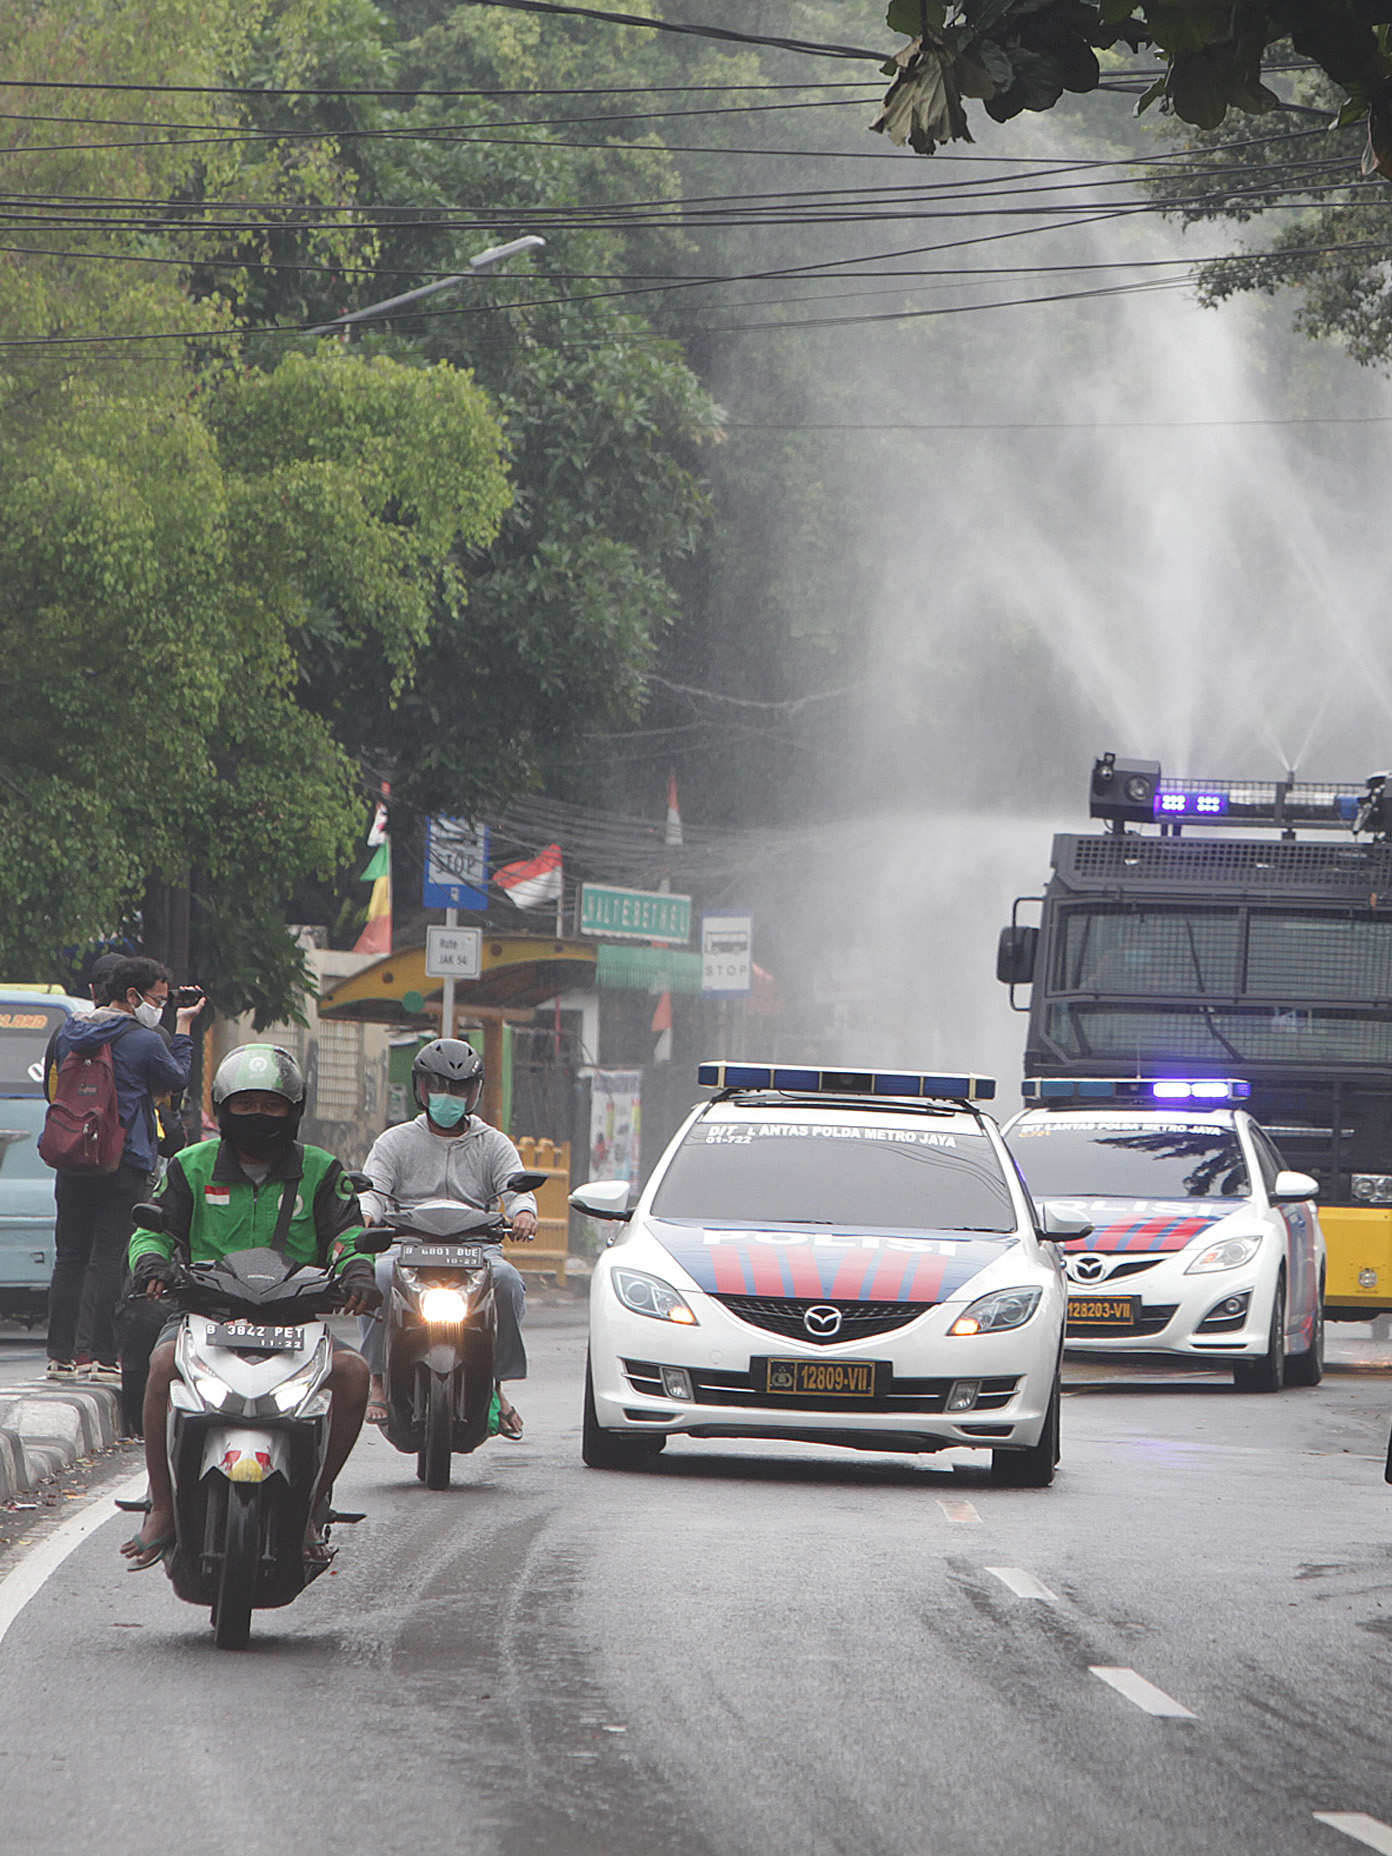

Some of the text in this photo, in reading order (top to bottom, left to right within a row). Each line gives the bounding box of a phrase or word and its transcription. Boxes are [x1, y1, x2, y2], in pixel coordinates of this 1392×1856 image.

[435, 851, 476, 875] STOP
[704, 964, 748, 977] STOP
[708, 1125, 737, 1136] DIT
[812, 1127, 861, 1138] POLDA
[864, 1129, 916, 1142] METRO
[919, 1132, 957, 1147] JAYA
[1188, 1126, 1221, 1136] JAYA
[706, 1136, 752, 1144] 01-722
[703, 1229, 957, 1256] POLISI
[405, 1246, 413, 1255] B
[457, 1247, 478, 1257] BUE
[227, 1325, 265, 1337] 3842
[274, 1326, 303, 1338] PET
[801, 1365, 868, 1391] 12809-VII
